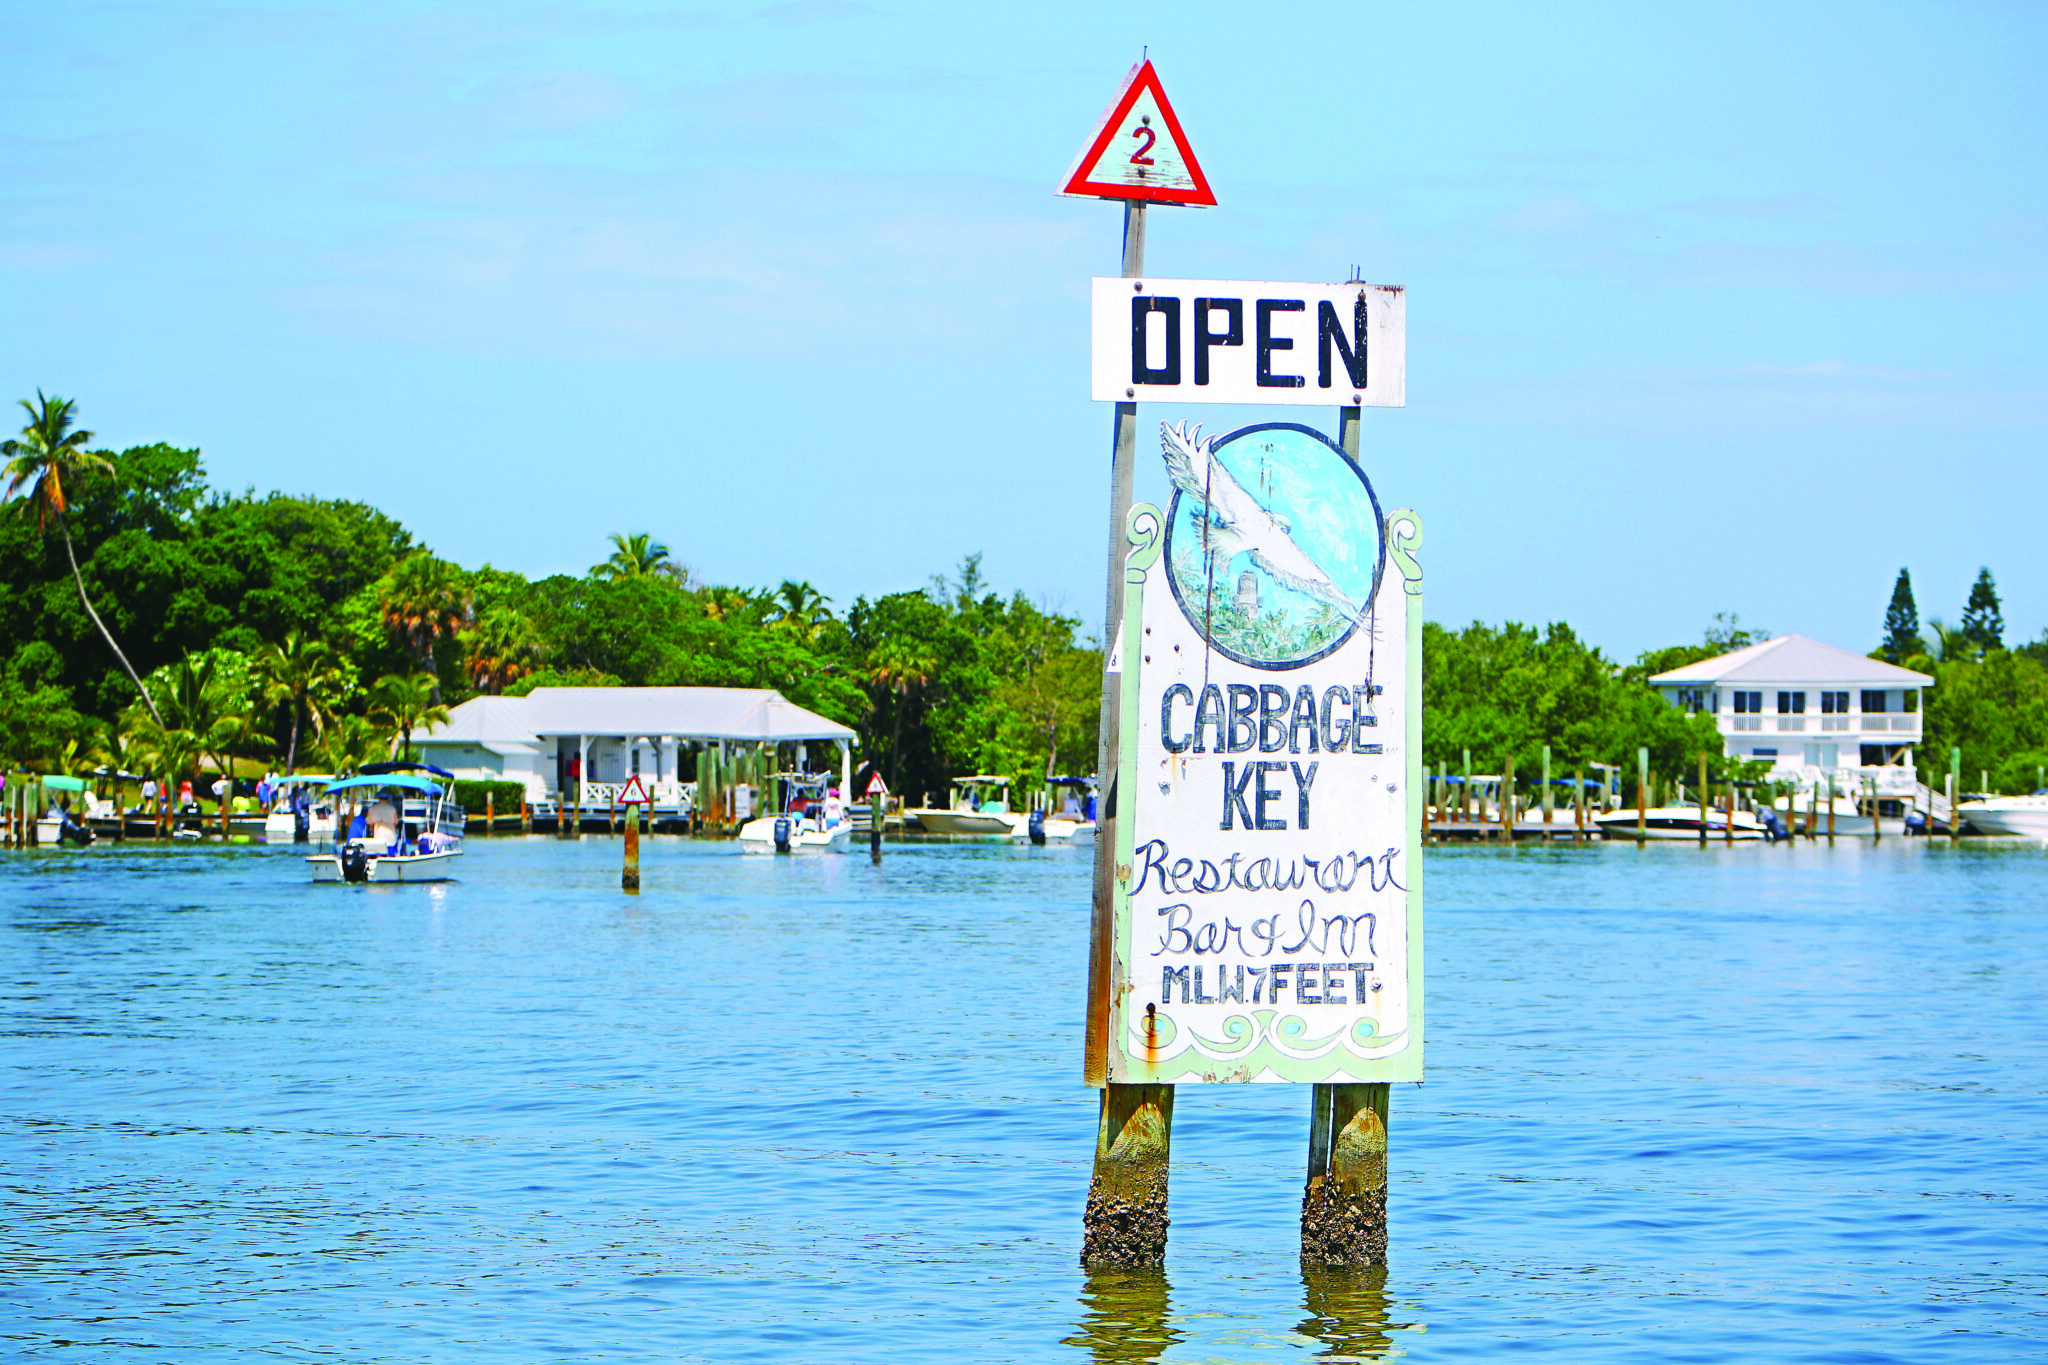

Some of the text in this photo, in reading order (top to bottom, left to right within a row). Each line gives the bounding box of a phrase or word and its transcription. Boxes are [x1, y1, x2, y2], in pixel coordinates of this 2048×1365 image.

[1130, 126, 1156, 166] 2
[1131, 295, 1368, 389] OPEN
[1161, 682, 1384, 754] CABBAGE
[1219, 760, 1320, 831] KEY
[1126, 838, 1413, 897] Restaurant
[1150, 903, 1255, 957] Bar
[1281, 899, 1379, 958] Inn
